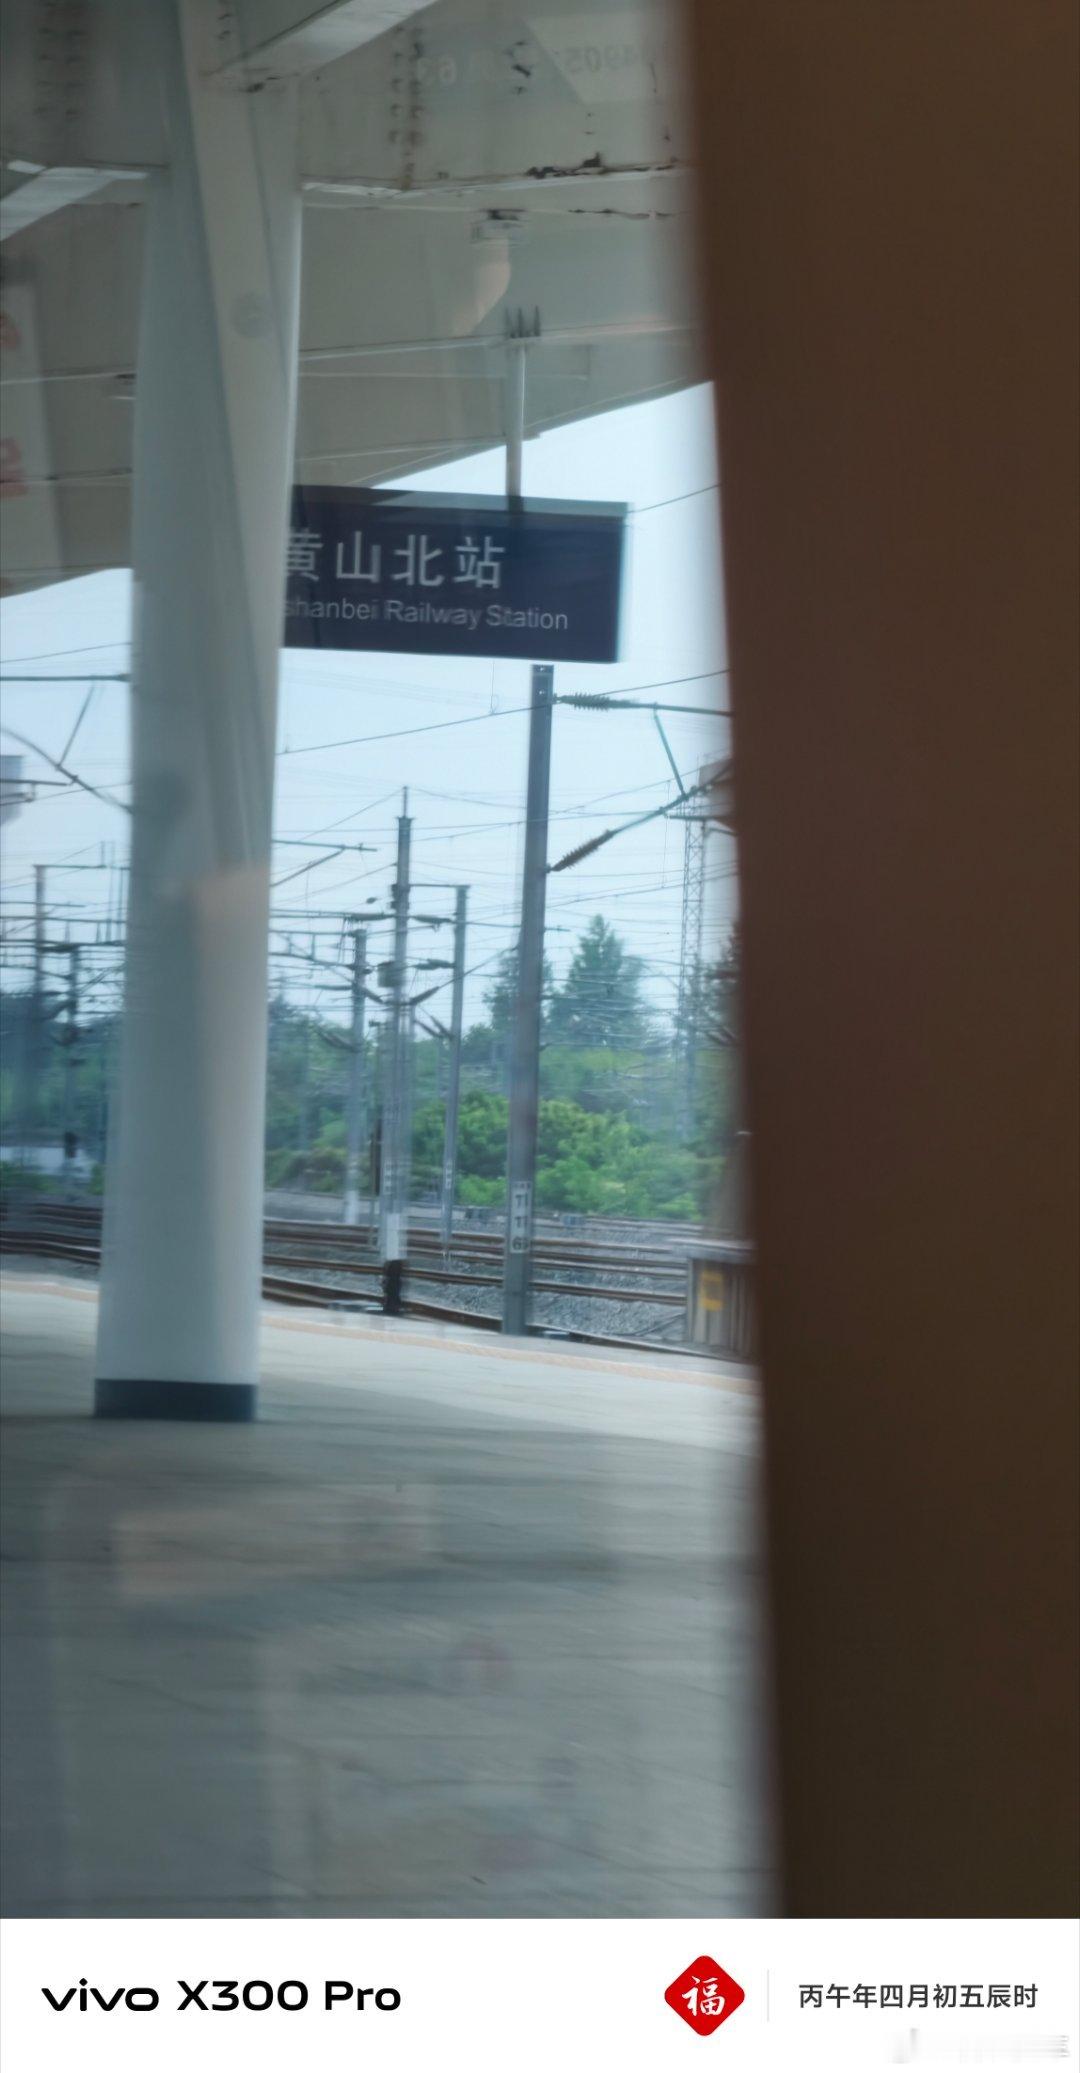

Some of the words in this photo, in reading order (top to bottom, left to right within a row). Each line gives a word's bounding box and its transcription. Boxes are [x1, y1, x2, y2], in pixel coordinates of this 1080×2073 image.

[286, 528, 505, 590] 黄山北站
[284, 598, 378, 620] shanbei
[386, 600, 482, 630] Railway
[486, 603, 569, 630] Station
